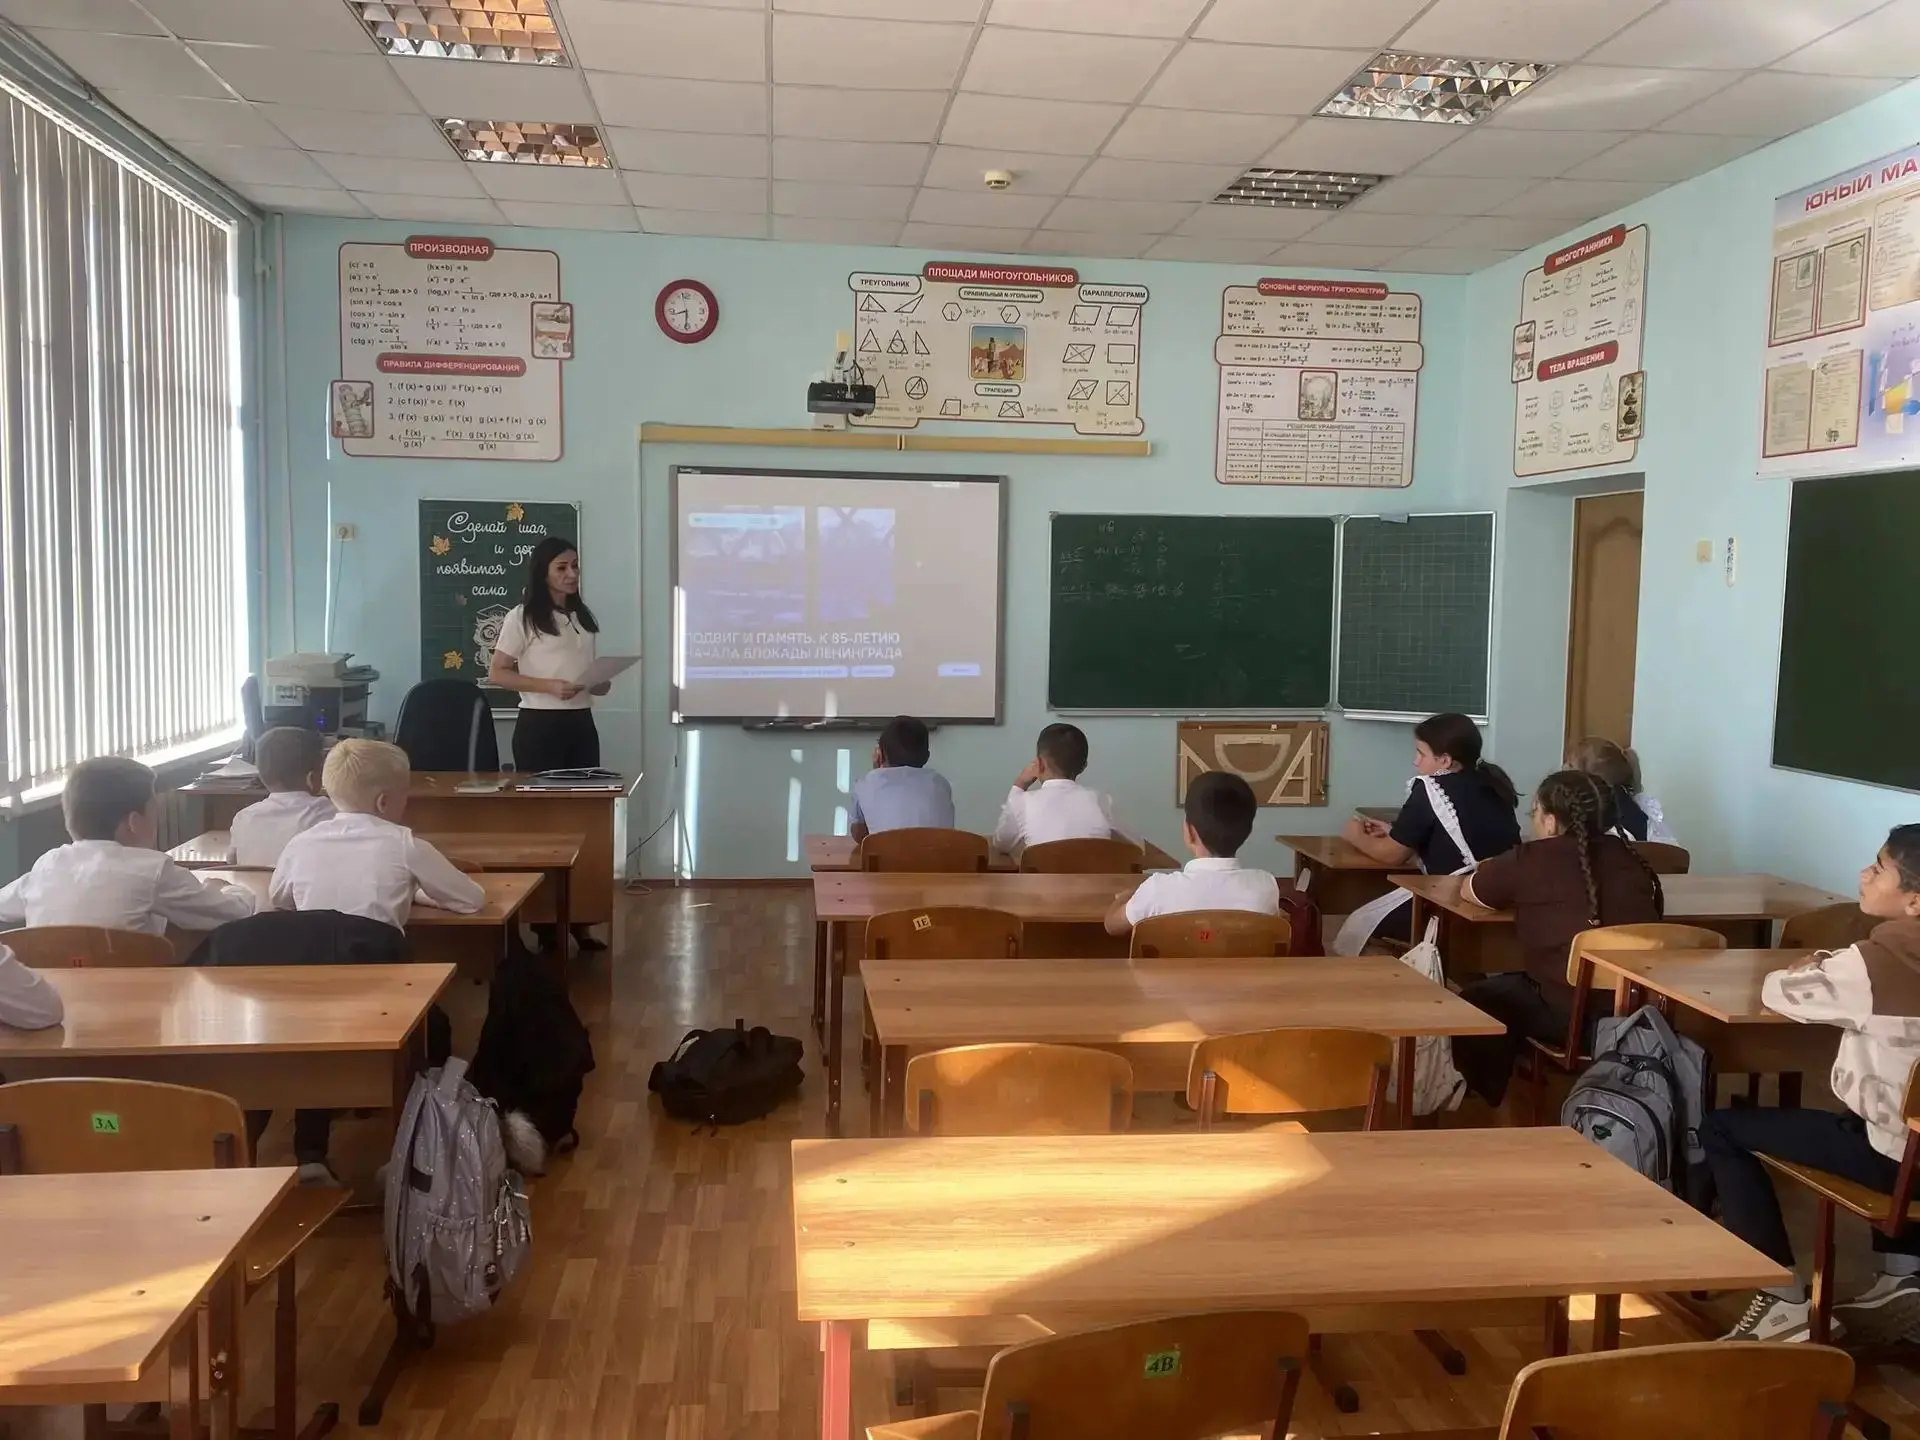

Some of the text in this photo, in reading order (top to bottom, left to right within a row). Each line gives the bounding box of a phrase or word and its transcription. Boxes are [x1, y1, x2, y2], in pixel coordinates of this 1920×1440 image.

[1806, 158, 1918, 211] ЮНЫЙ МА
[410, 243, 489, 255] ПРОИЗВОДНАЯ
[1555, 235, 1614, 266] МНОГОГРАННИКИ
[928, 268, 1074, 283] ПЛОЩАДИ МНОГОУГОЛЬНИКОВ
[860, 279, 910, 288] ТРЕУГОЛЬНИК
[1260, 283, 1385, 294] ОСНОВНЫЕ ФОРМУЛЫ ТРИГОНОМЕТРИИ
[1082, 289, 1146, 299] ПАРАЛЛЕЛОГРАММ
[384, 360, 520, 372] ПРАВИЛА ДИФФЕРЕНЦИРОВАНИЯ
[1550, 351, 1605, 374] ТЕЛА ВРАЩЕНИЯ
[447, 511, 547, 543] Сделай шаг,
[494, 545, 504, 554] и
[437, 558, 506, 575] появится
[472, 586, 508, 596] сама
[819, 633, 828, 644] К
[743, 648, 811, 659] БЛОКАДЫ
[815, 648, 903, 660] ЛЕНИНГРАДА
